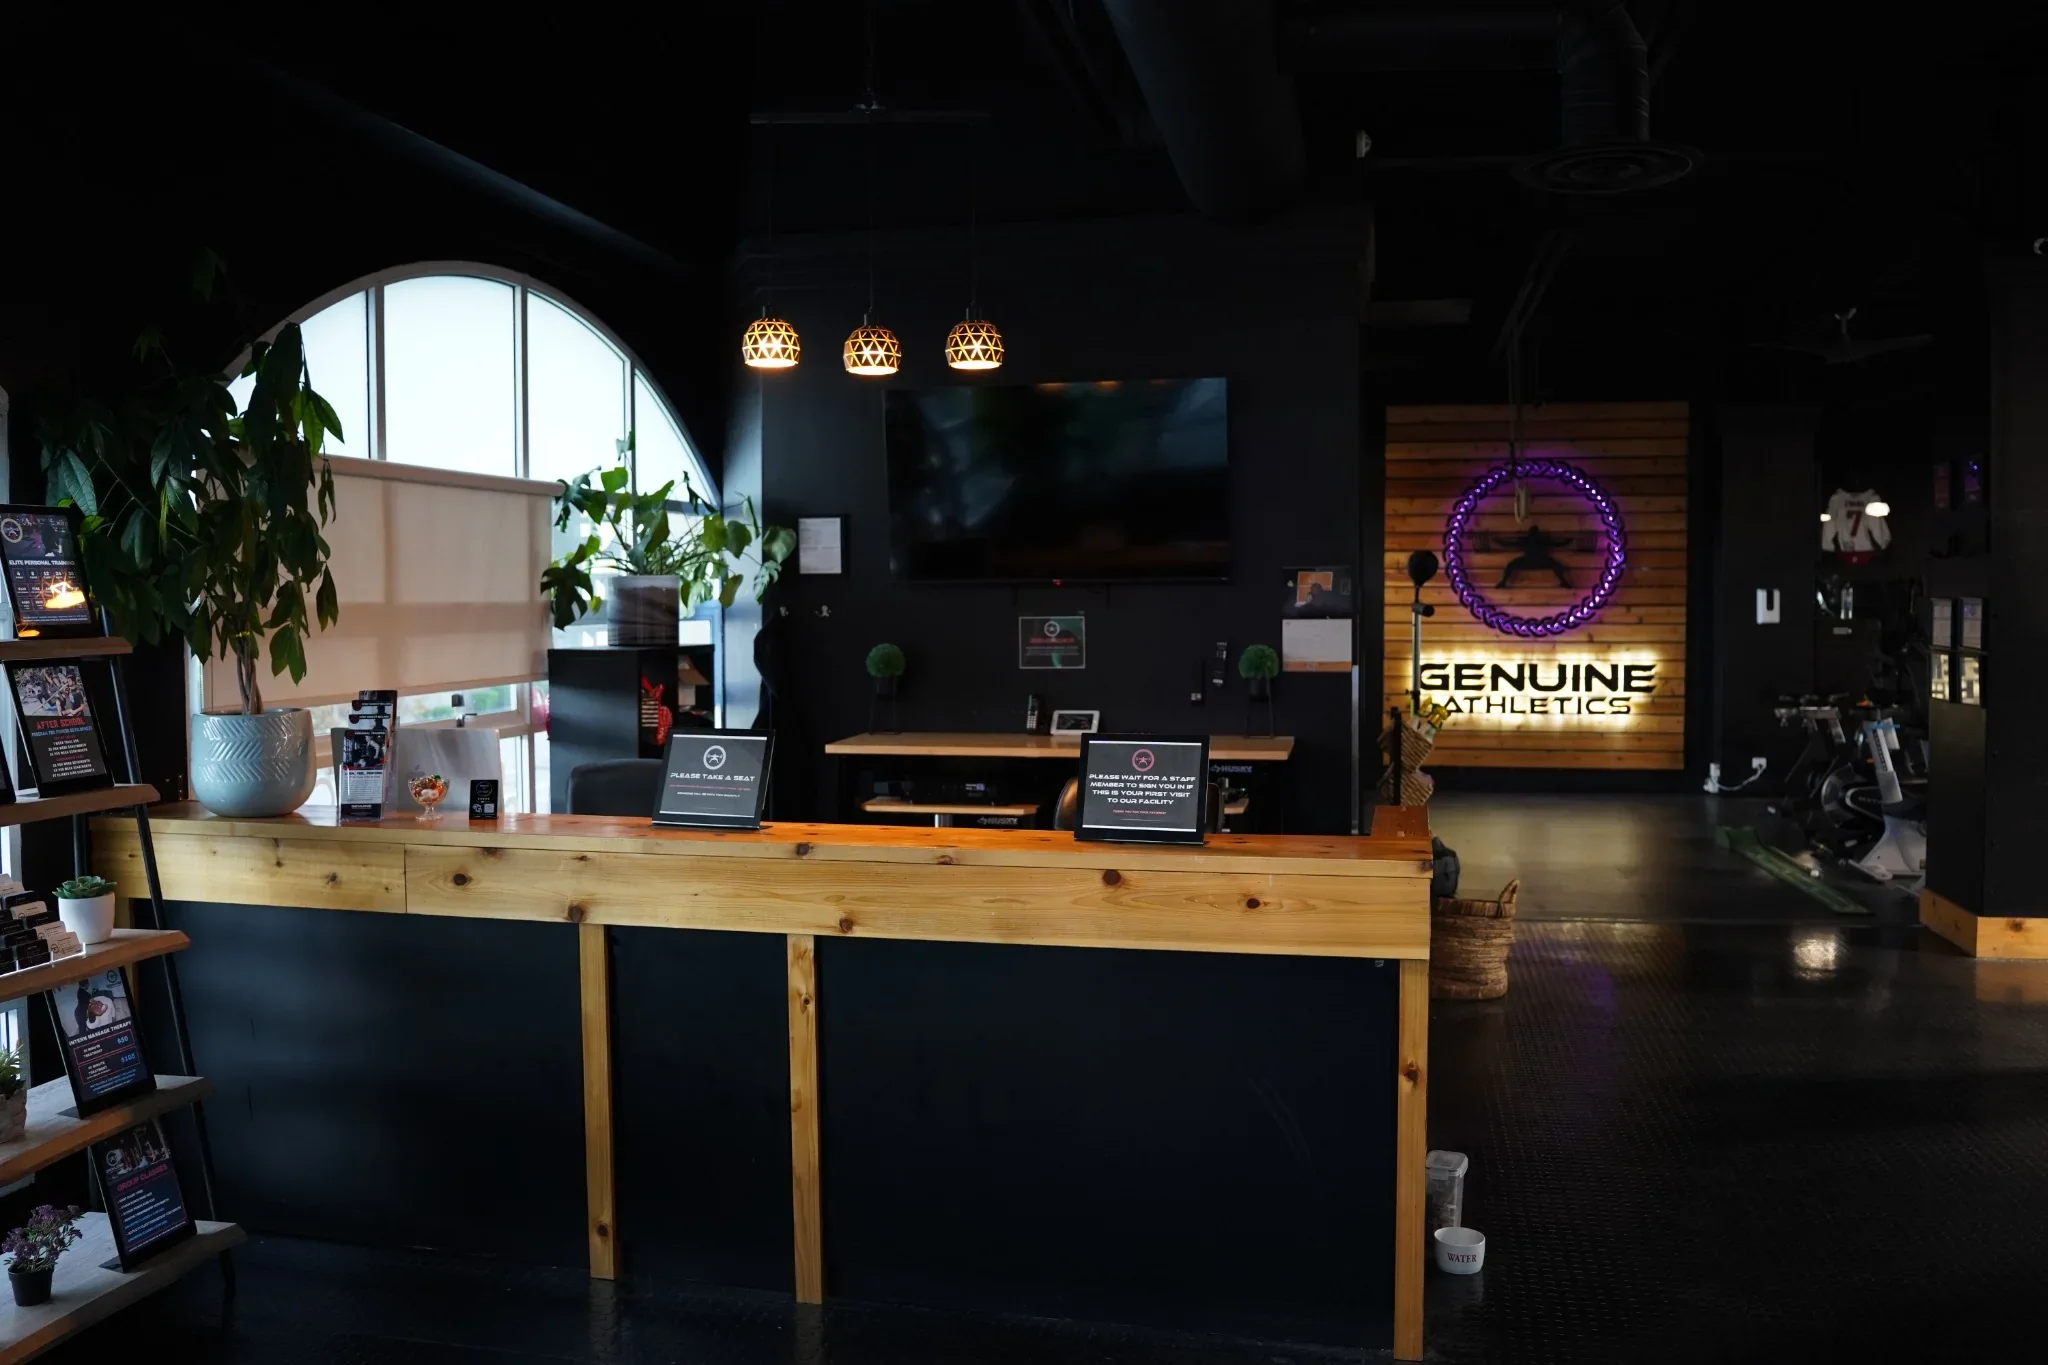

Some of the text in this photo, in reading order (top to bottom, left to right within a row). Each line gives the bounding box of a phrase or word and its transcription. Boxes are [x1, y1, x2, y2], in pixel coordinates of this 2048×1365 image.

[1846, 510, 1862, 536] 7
[1420, 664, 1656, 692] GENUINE
[1444, 696, 1632, 714] ATHLETICS
[36, 717, 85, 730] AFTER SCHOOL
[69, 1021, 132, 1046] INTERN MASSAGE THERAPY
[117, 1177, 139, 1191] GROUP
[140, 1164, 168, 1181] CLASSES
[1447, 1252, 1476, 1262] WATER
